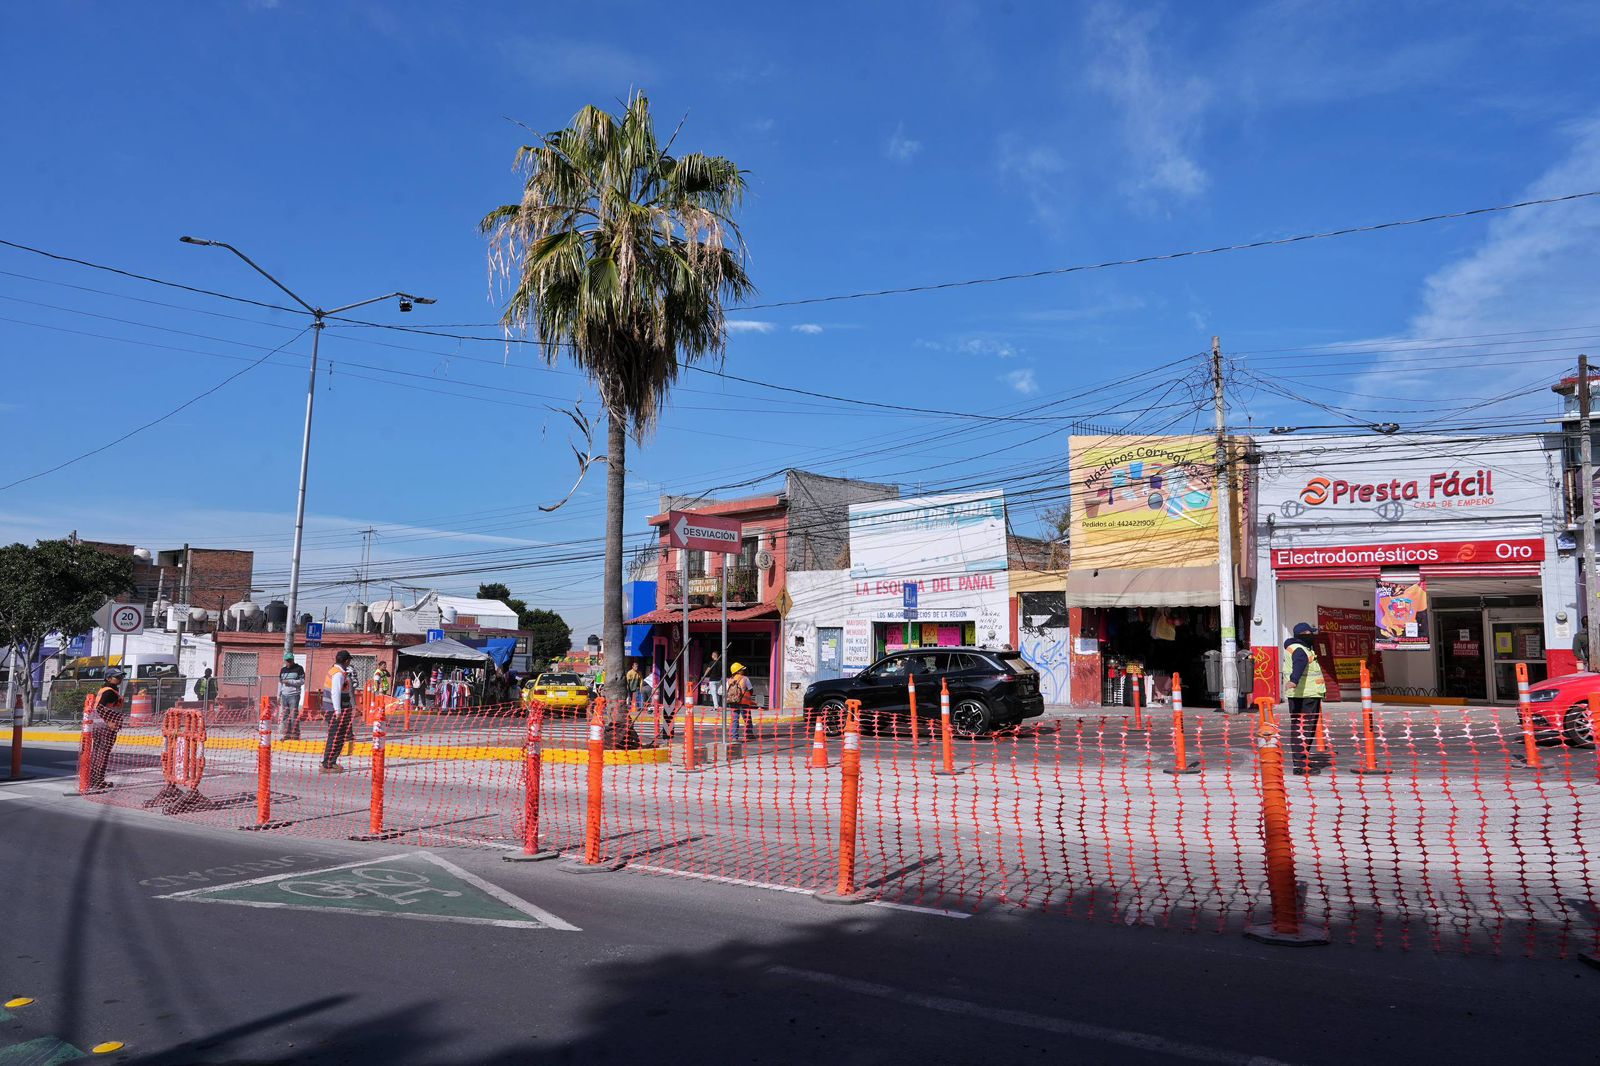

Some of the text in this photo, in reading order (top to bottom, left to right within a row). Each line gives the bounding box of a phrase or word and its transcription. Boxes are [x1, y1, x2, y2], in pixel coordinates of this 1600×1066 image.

[1332, 470, 1494, 505] Presta Fácil
[1414, 501, 1437, 509] CASA
[1457, 498, 1495, 507] EMPEÑO
[683, 527, 736, 540] DESVIACIÓN
[1277, 542, 1532, 565] Electrodomésticos Oro
[856, 574, 996, 596] LA ESQUA DEL PAÑAL
[121, 612, 134, 621] 20
